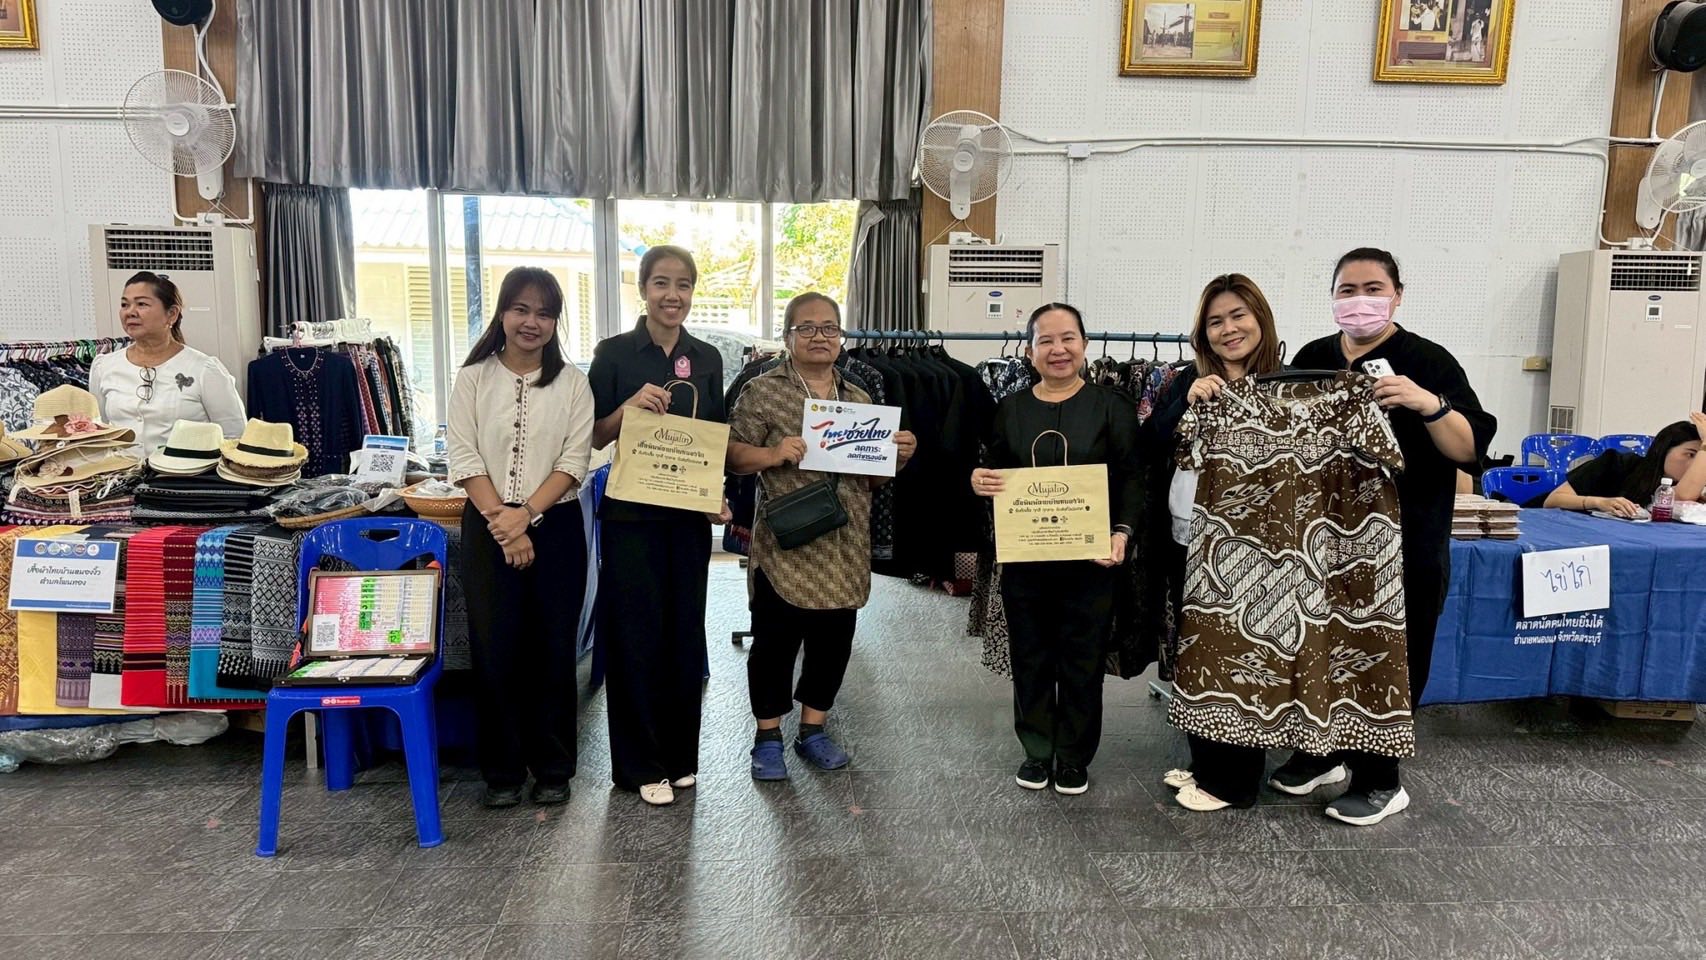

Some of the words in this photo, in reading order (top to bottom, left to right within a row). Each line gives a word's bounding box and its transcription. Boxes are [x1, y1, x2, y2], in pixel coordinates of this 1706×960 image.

[658, 428, 689, 445] Mujalin
[811, 417, 892, 449] ไทยช่วยไทย
[1031, 482, 1065, 497] Mujalin
[1540, 555, 1591, 592] ไข่ไก่
[1515, 613, 1604, 630] ตลาดนัดคนไทยยิ้มได้
[1558, 630, 1602, 647] จังหวัดสระบุรี
